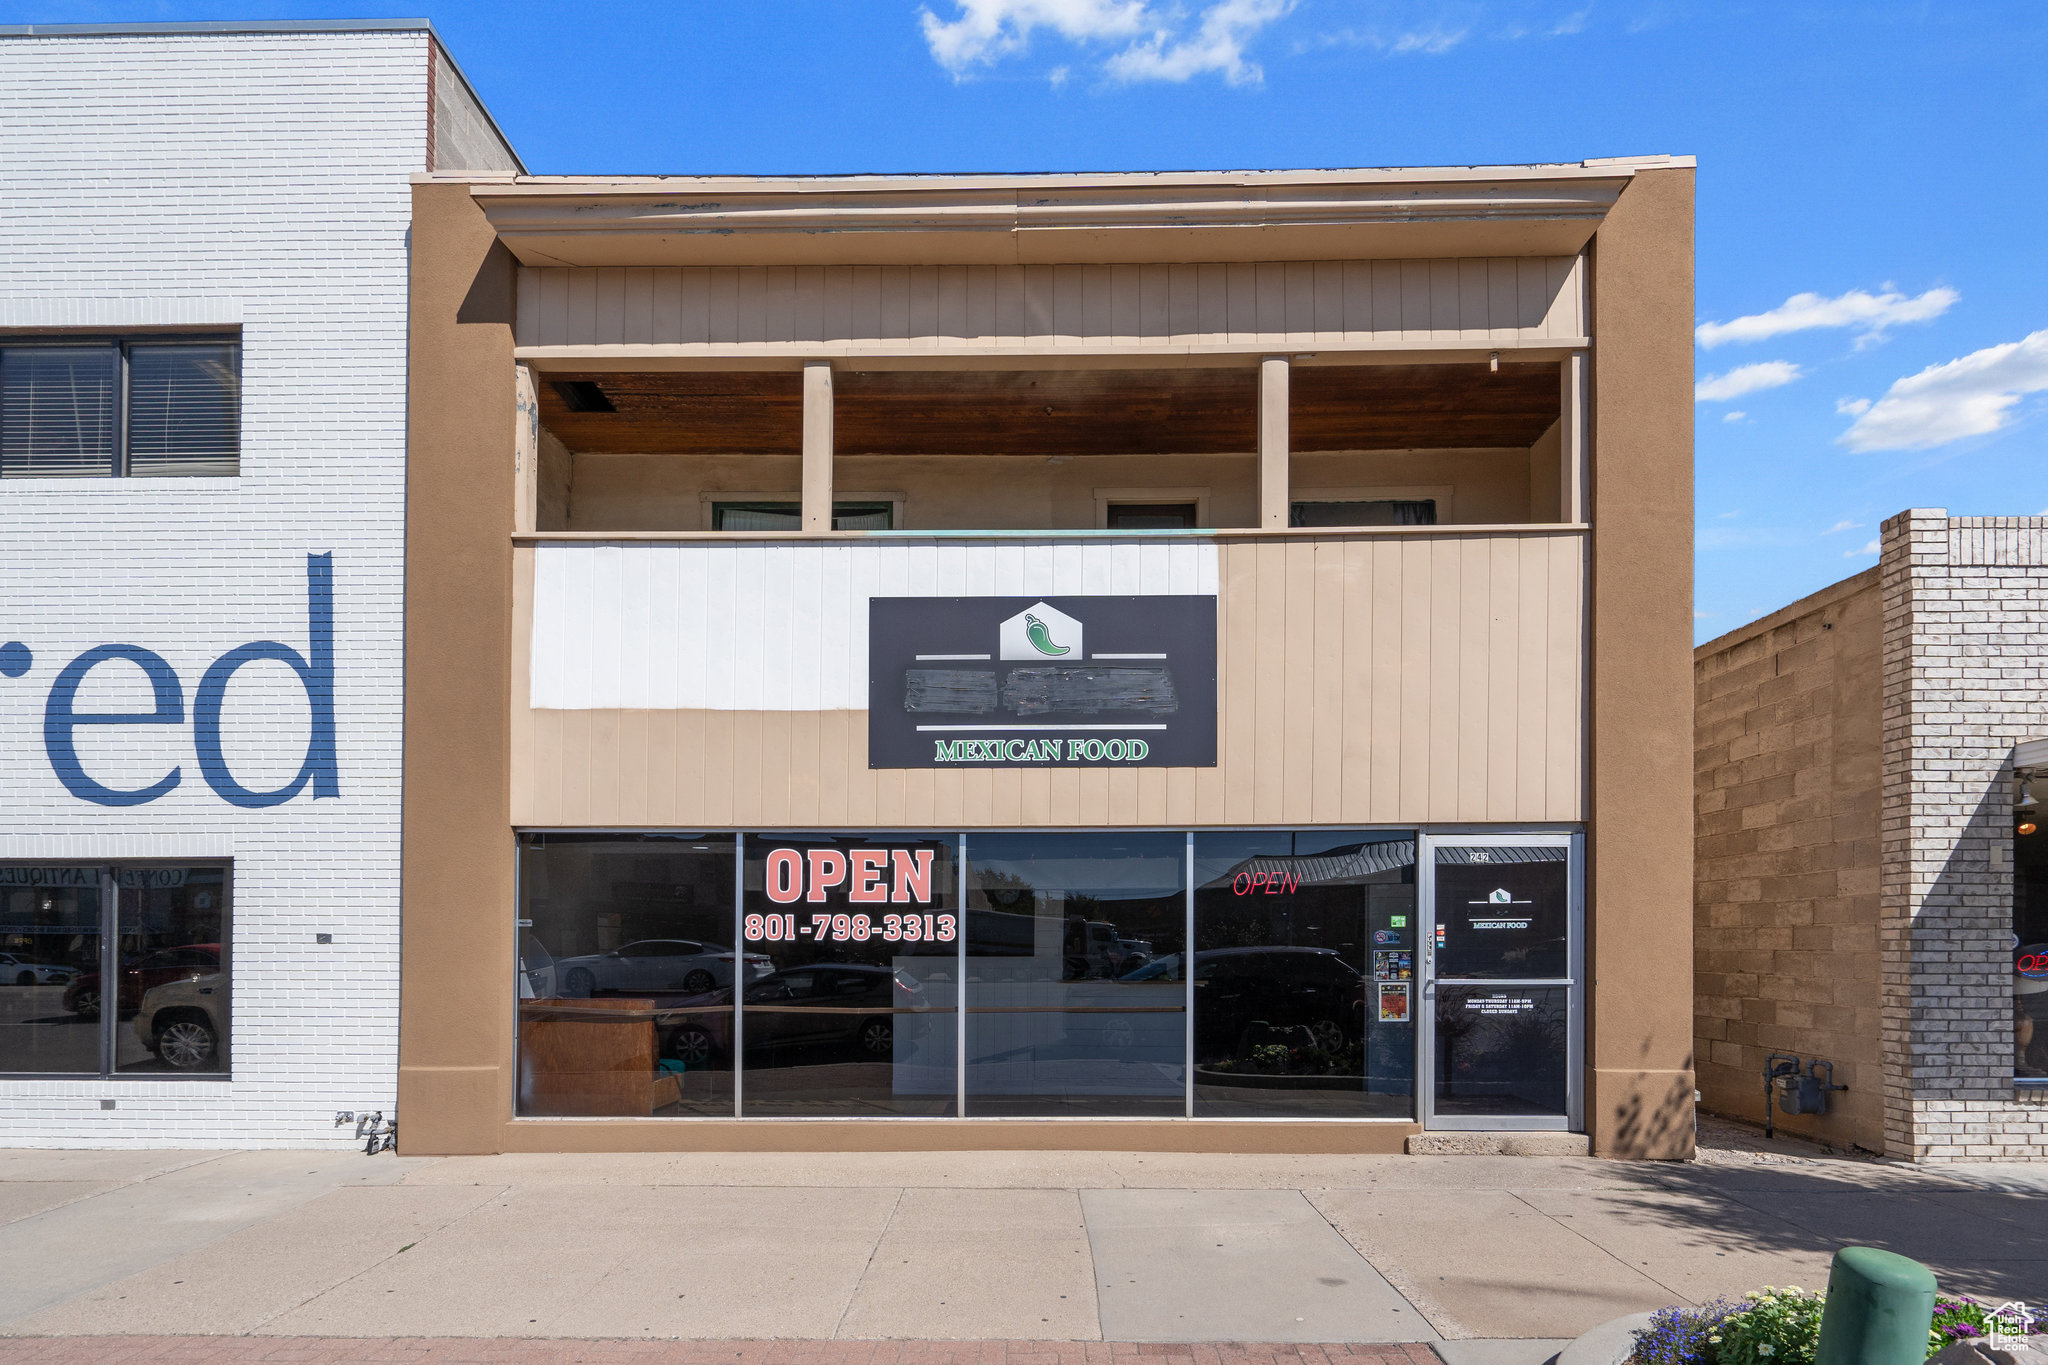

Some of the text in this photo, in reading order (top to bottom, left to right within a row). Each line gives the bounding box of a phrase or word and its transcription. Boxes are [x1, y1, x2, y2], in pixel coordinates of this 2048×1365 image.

[0, 551, 340, 808] ed
[934, 738, 1149, 762] MEXICAN FOOD
[1470, 853, 1488, 862] 242
[766, 848, 934, 903] OPEN
[1233, 872, 1301, 896] OPEN
[744, 914, 956, 941] 801-798-3313
[2017, 954, 2048, 972] OP
